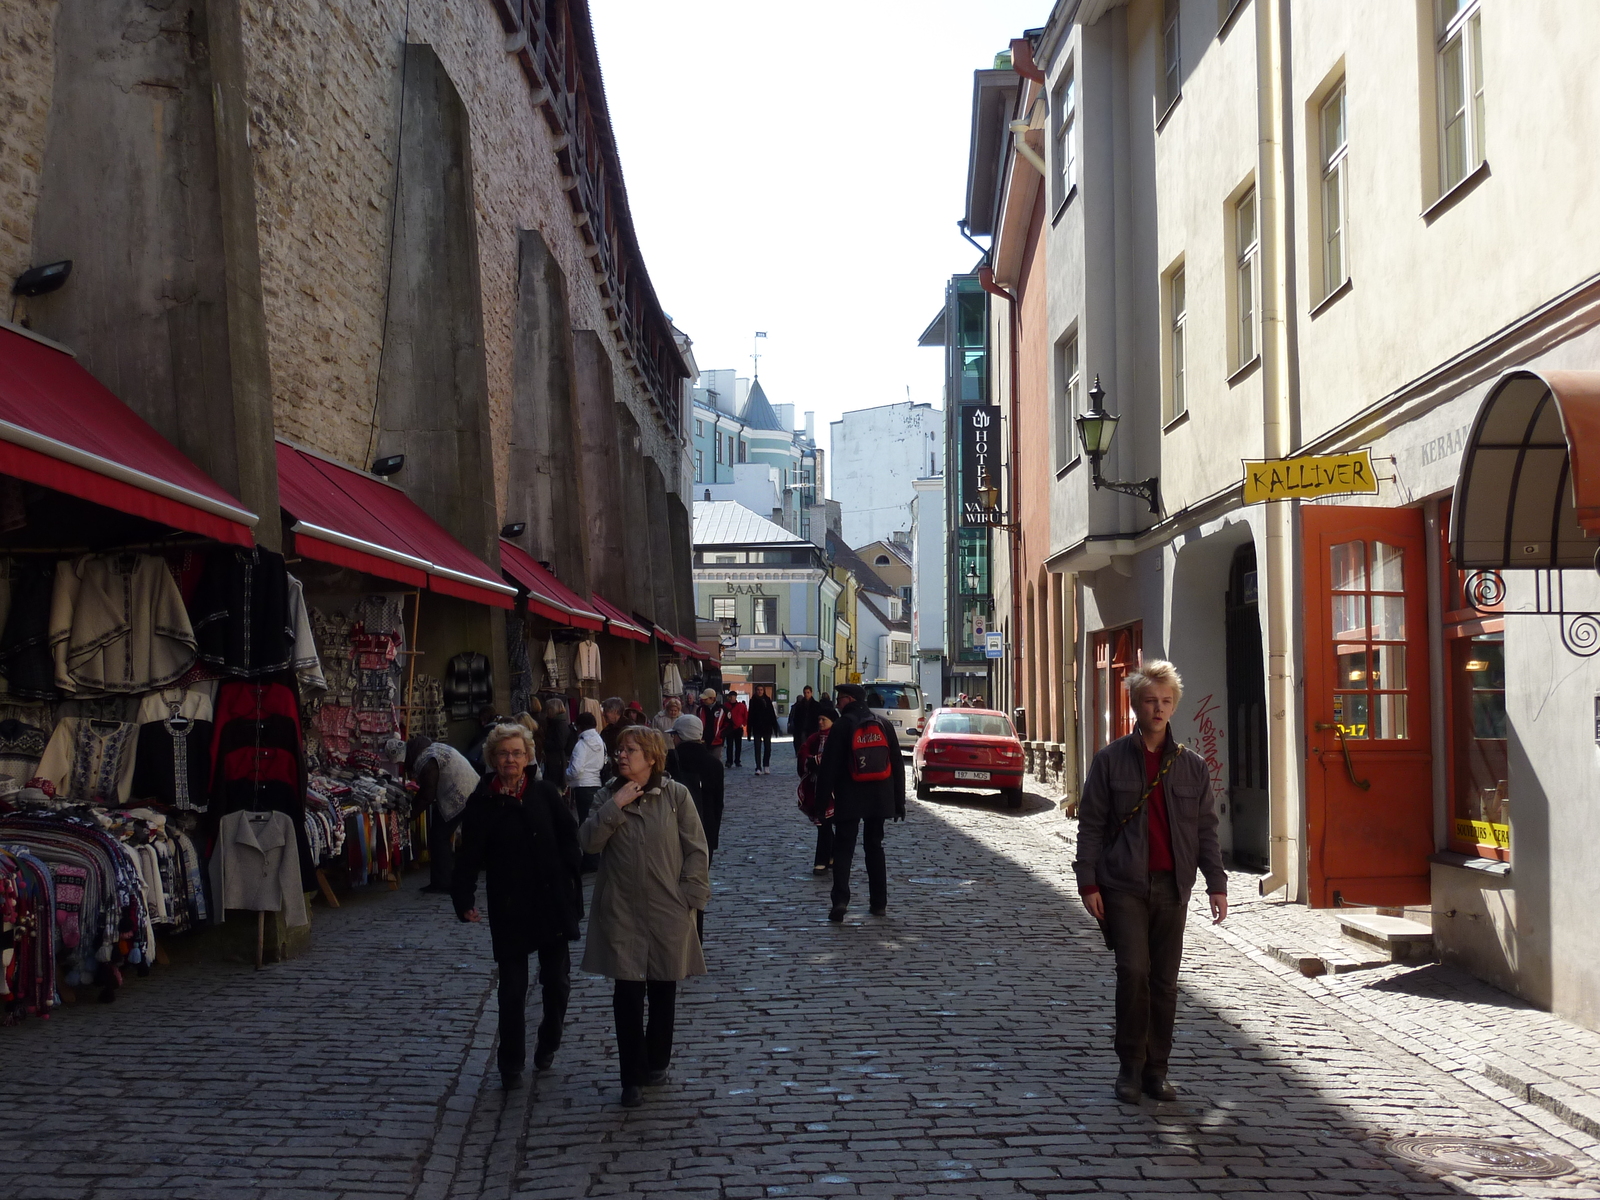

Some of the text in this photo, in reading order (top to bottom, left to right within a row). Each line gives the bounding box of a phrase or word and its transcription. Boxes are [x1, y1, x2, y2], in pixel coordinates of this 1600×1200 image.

[975, 430, 988, 488] HOTEL
[1253, 460, 1369, 493] KALLIVER
[965, 502, 1000, 513] VAA
[966, 513, 999, 523] WIRU
[726, 582, 765, 596] BAAR
[859, 756, 867, 768] 3
